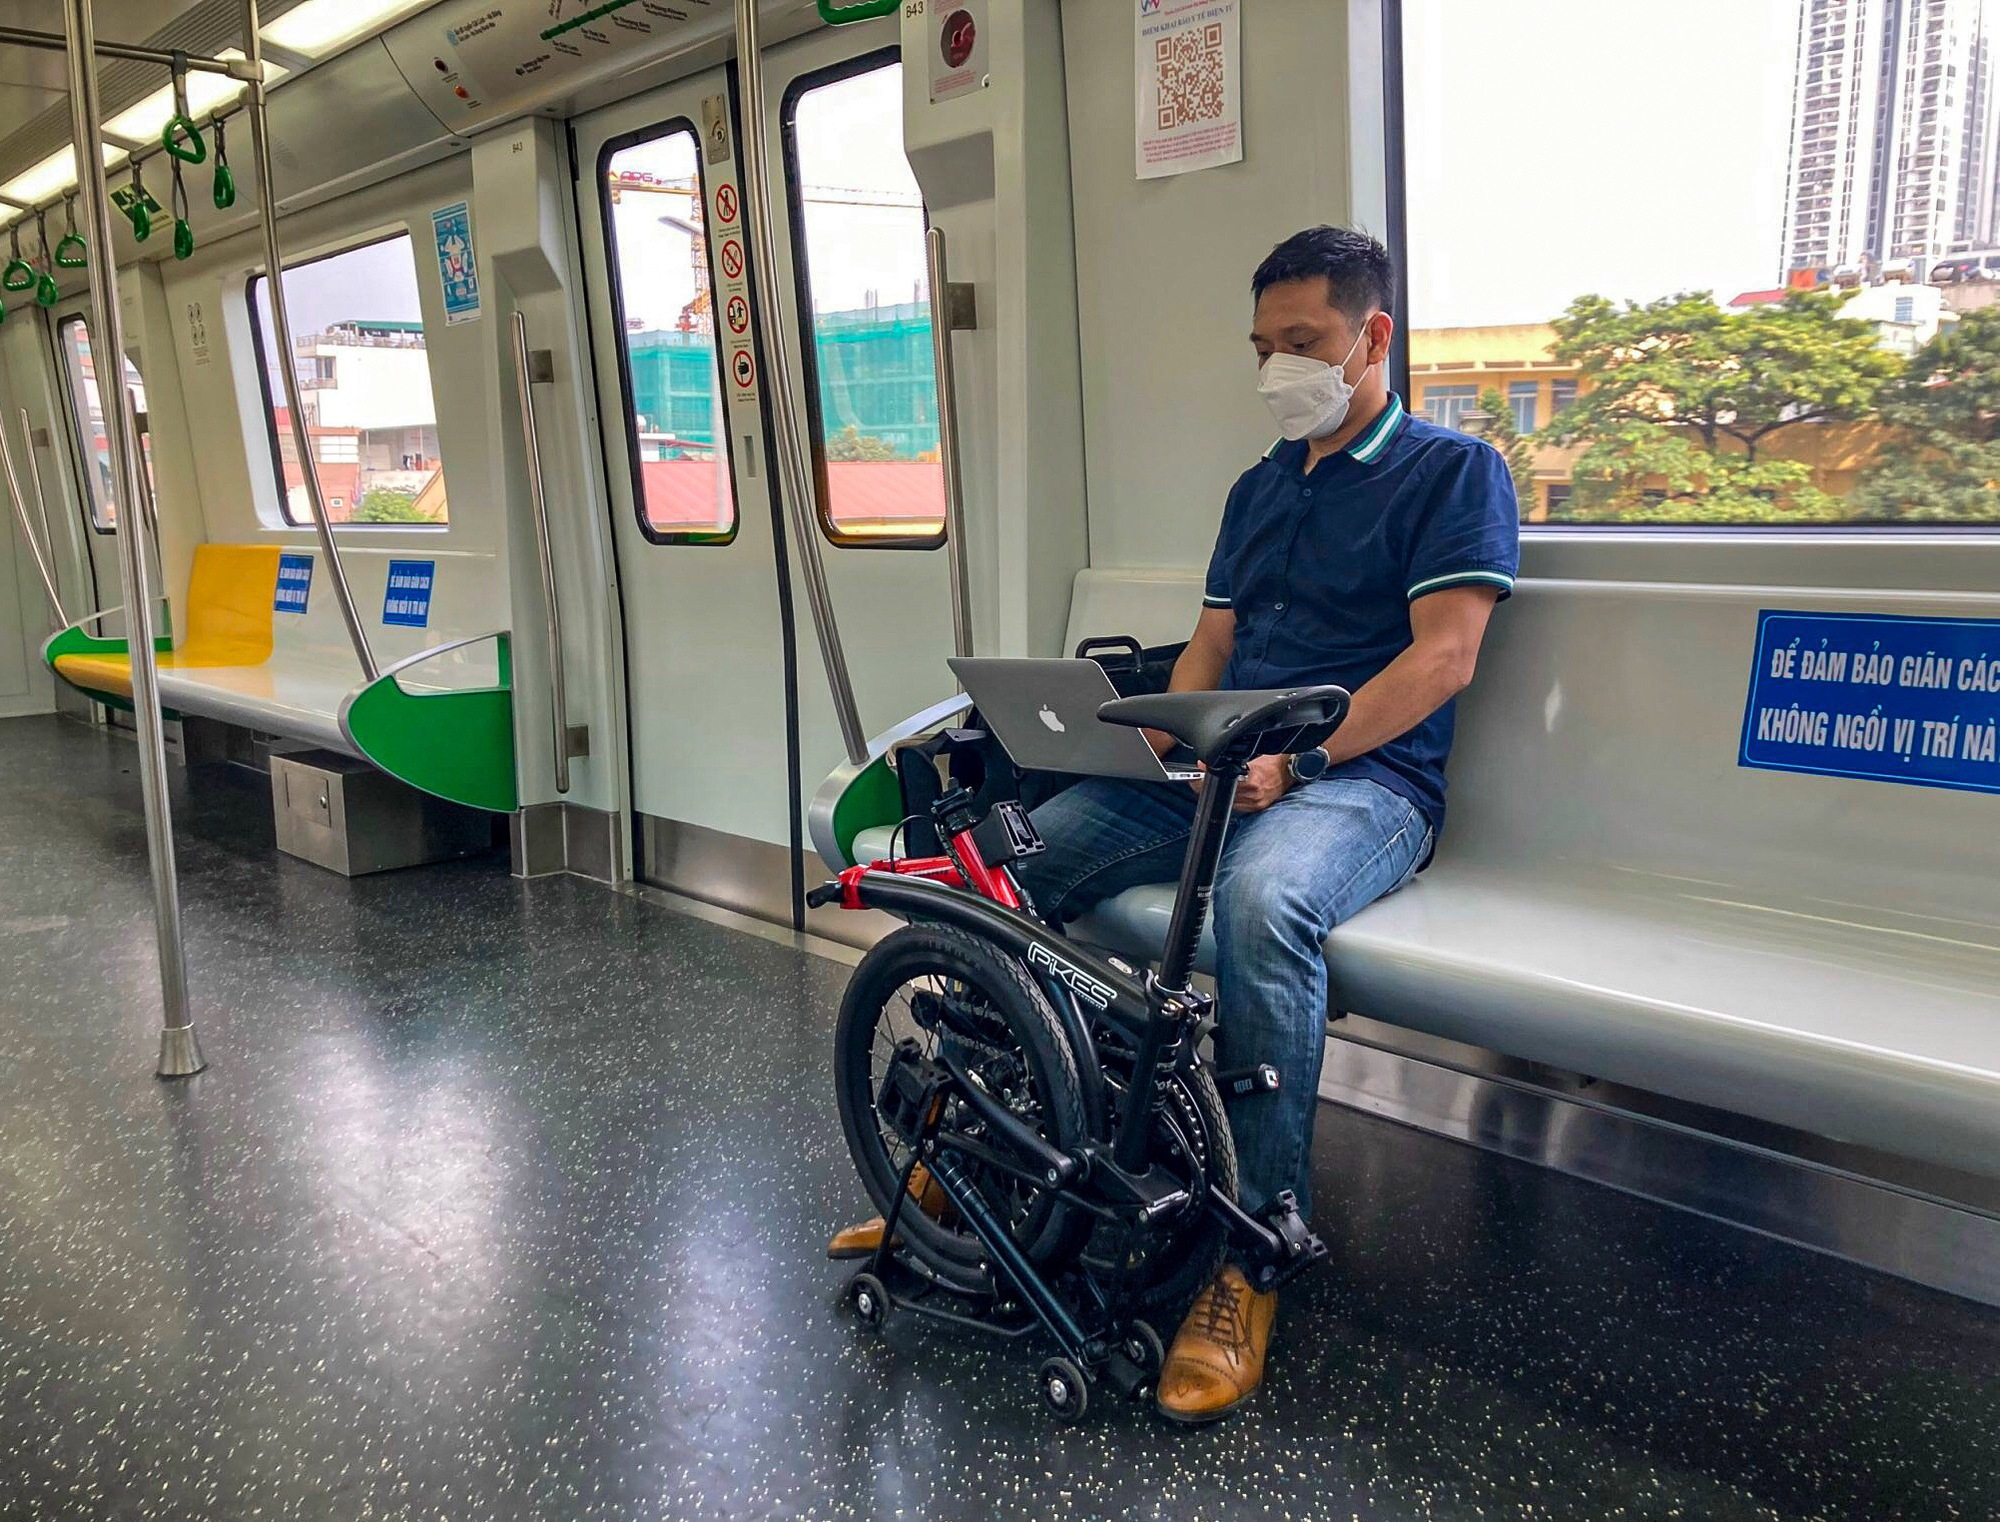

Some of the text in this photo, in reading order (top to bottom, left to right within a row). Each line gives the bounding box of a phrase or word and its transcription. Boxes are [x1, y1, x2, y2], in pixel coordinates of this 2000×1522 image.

[1770, 637, 1800, 679] ĐỂ
[1800, 638, 1848, 682] ĐẢM
[1851, 641, 1895, 686] BẢO
[1899, 651, 1953, 689] GIÃN
[1757, 703, 2000, 763] KHÔNG NGỒI VỊ TRÍ NÀ
